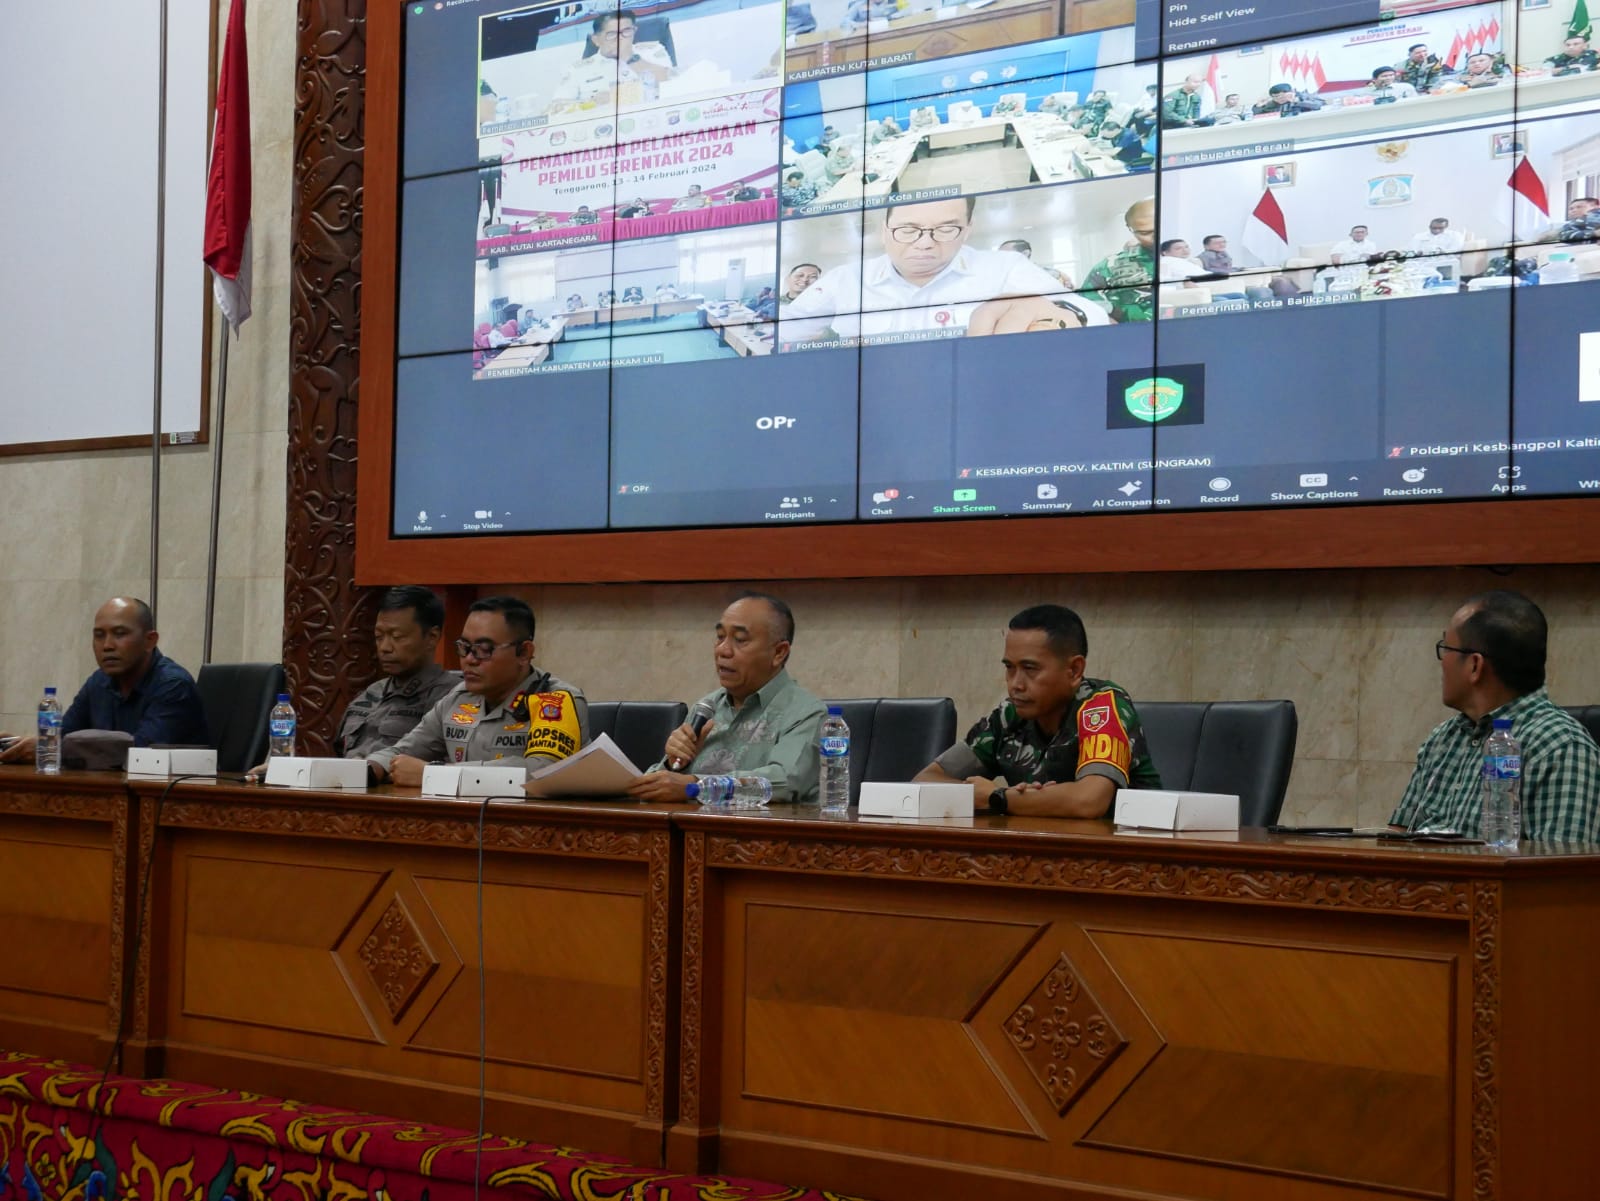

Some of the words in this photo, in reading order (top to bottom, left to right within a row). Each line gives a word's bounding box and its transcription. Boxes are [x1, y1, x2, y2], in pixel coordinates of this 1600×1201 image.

[1169, 3, 1188, 13] Pin
[1169, 17, 1197, 28] Hide
[1200, 12, 1223, 23] Self
[1226, 7, 1255, 18] View
[1168, 38, 1217, 52] Rename
[788, 64, 846, 81] KABUPATEN
[848, 59, 878, 71] KUTAI
[880, 53, 914, 65] BARAT
[519, 141, 627, 173] PEMANTAUAN
[630, 119, 757, 155] PELAKSANAAN
[1184, 147, 1251, 164] Kabupaten
[1255, 142, 1291, 154] Berau
[538, 165, 596, 187] PEMILU
[600, 149, 685, 177] SERENTAK
[688, 142, 734, 162] 2024
[633, 173, 645, 184] 14
[648, 168, 689, 181] Februari
[691, 163, 717, 175] 2024
[800, 200, 849, 214] Command
[888, 192, 913, 204] Kota
[915, 186, 958, 200] Bontang
[510, 243, 534, 252] KUTAI
[536, 234, 598, 248] KARTANEGARA
[1182, 301, 1251, 316] Pemerintah
[1253, 299, 1283, 310] Kota
[1287, 292, 1357, 307] Balikpapan
[796, 338, 855, 351] Forkompida
[487, 366, 541, 378] PEMERINTAH
[541, 361, 591, 372] KABUPATEN
[592, 358, 641, 369] MAHAKAM
[643, 355, 662, 364] ULU
[756, 416, 796, 430] OPr
[1410, 443, 1469, 456] Poldagri
[1472, 439, 1561, 453] Kesbangpol
[1566, 437, 1600, 448] Kalti
[976, 466, 1050, 477] KESBANGPOL
[1053, 464, 1089, 473] PROV.
[1091, 461, 1135, 472] KALTIM
[1137, 457, 1212, 471] (SUNGRAM)
[1383, 486, 1444, 497] Reactions
[1491, 483, 1527, 493] Apps
[802, 496, 813, 504] 15
[1200, 494, 1240, 503] Record
[1270, 491, 1303, 501] Show
[1306, 489, 1359, 501] Captions
[933, 505, 961, 514] Share
[963, 503, 996, 513] Screen
[1022, 501, 1072, 511] Summary
[1092, 499, 1105, 508] AI
[1106, 497, 1171, 509] Companion
[765, 510, 816, 520] Participants
[871, 507, 893, 516] Chat
[463, 523, 480, 531] Stop
[481, 522, 503, 530] Video
[445, 727, 468, 739] BUDI
[496, 733, 526, 746] POLRI
[1502, 759, 1520, 769] AQU
